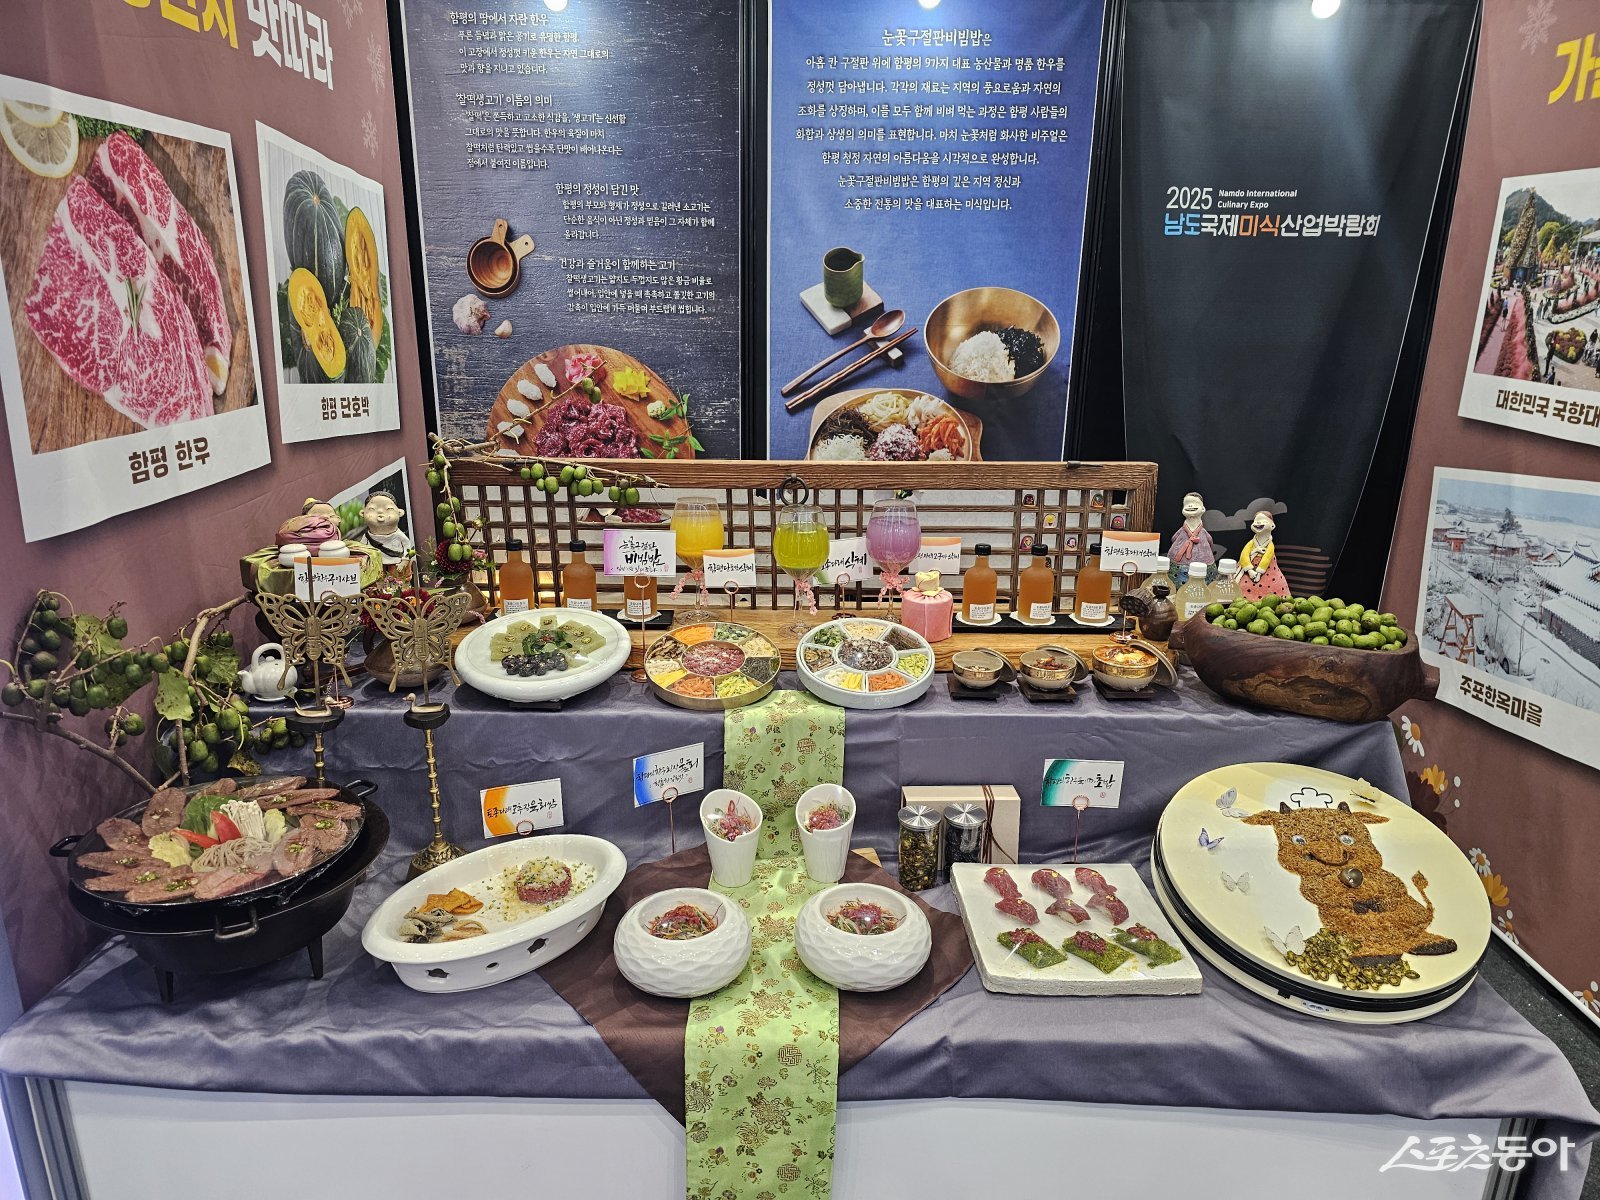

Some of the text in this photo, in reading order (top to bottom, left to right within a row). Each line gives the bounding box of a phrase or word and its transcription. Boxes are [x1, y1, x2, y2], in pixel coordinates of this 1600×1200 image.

[450, 12, 549, 25] 함평의 땅에서 자란 한우
[499, 31, 514, 41] 맑은
[539, 32, 561, 42] 유명한
[563, 32, 579, 42] 함평.
[882, 28, 992, 46] 눈꽃구절판비빔밥은
[247, 0, 334, 90] 맛따라
[459, 47, 609, 59] 이 고장에서 정성껏 키운 한우는 자연 그대로의
[460, 63, 547, 74] 맛과 향을 지니고 있습니다.
[806, 56, 1065, 70] 아홉 칸 구절판 위에 함평의 9가지 대표 농산물과 명품 한우를
[1548, 33, 1600, 104] 가
[807, 81, 1061, 94] 정성껏 담아냅니다. 각각의 재료는 지역의 풍요로움과 자연의
[507, 94, 532, 106] 이름의
[535, 95, 553, 107] 의미
[524, 112, 545, 123] 고소한
[547, 112, 571, 123] 식감을,
[798, 104, 1068, 118] 조화를 상징하며, 이를 모두 함께 비벼 먹는 과정은 함평 사람들의
[465, 128, 605, 139] 그대로의 맛을 뜻합니다. 한우의 육질이 마치
[796, 128, 1068, 142] 화합과 상생의 의미를 표현합니다. 마치 눈꽃처럼 화사한 비주얼은
[466, 143, 494, 153] 찰떡처럼
[557, 144, 578, 155] 단맛이
[467, 158, 488, 168] 점에서
[513, 159, 549, 169] 이름입니다.
[822, 152, 1039, 165] 함평 청정 자연의 아름다움을 시각적으로 완성합니다.
[838, 175, 1021, 188] 눈꽃구절판비빔밥은 함평의 깊은 지역 정신과
[555, 183, 639, 196] 함평의 정성이 담긴 맛
[844, 198, 1012, 210] 소중한 전통의 맛을 대표하는 미식입니다.
[1165, 186, 1298, 210] 2025 Namdo International
[562, 200, 584, 210] 함평의
[585, 200, 607, 210] 부모와
[608, 200, 629, 210] 형제가
[631, 201, 659, 211] 정성으로
[683, 201, 711, 212] 소고기는
[1217, 200, 1269, 210] Culinary Expo
[563, 215, 585, 225] 단순한
[587, 215, 607, 225] 음식이
[608, 216, 622, 226] 아닌
[624, 216, 645, 226] 정성과
[669, 216, 676, 226] 그
[677, 217, 699, 227] 자체가
[1164, 213, 1381, 237] 남도국제미식산업박람회
[559, 258, 675, 270] 건강과 즐거움이 함께하는 고기
[320, 395, 370, 420] 함평 단호박
[1496, 389, 1551, 418] 대한민국
[128, 436, 211, 485] 함평 한우
[1459, 675, 1543, 727] 주포한옥마을
